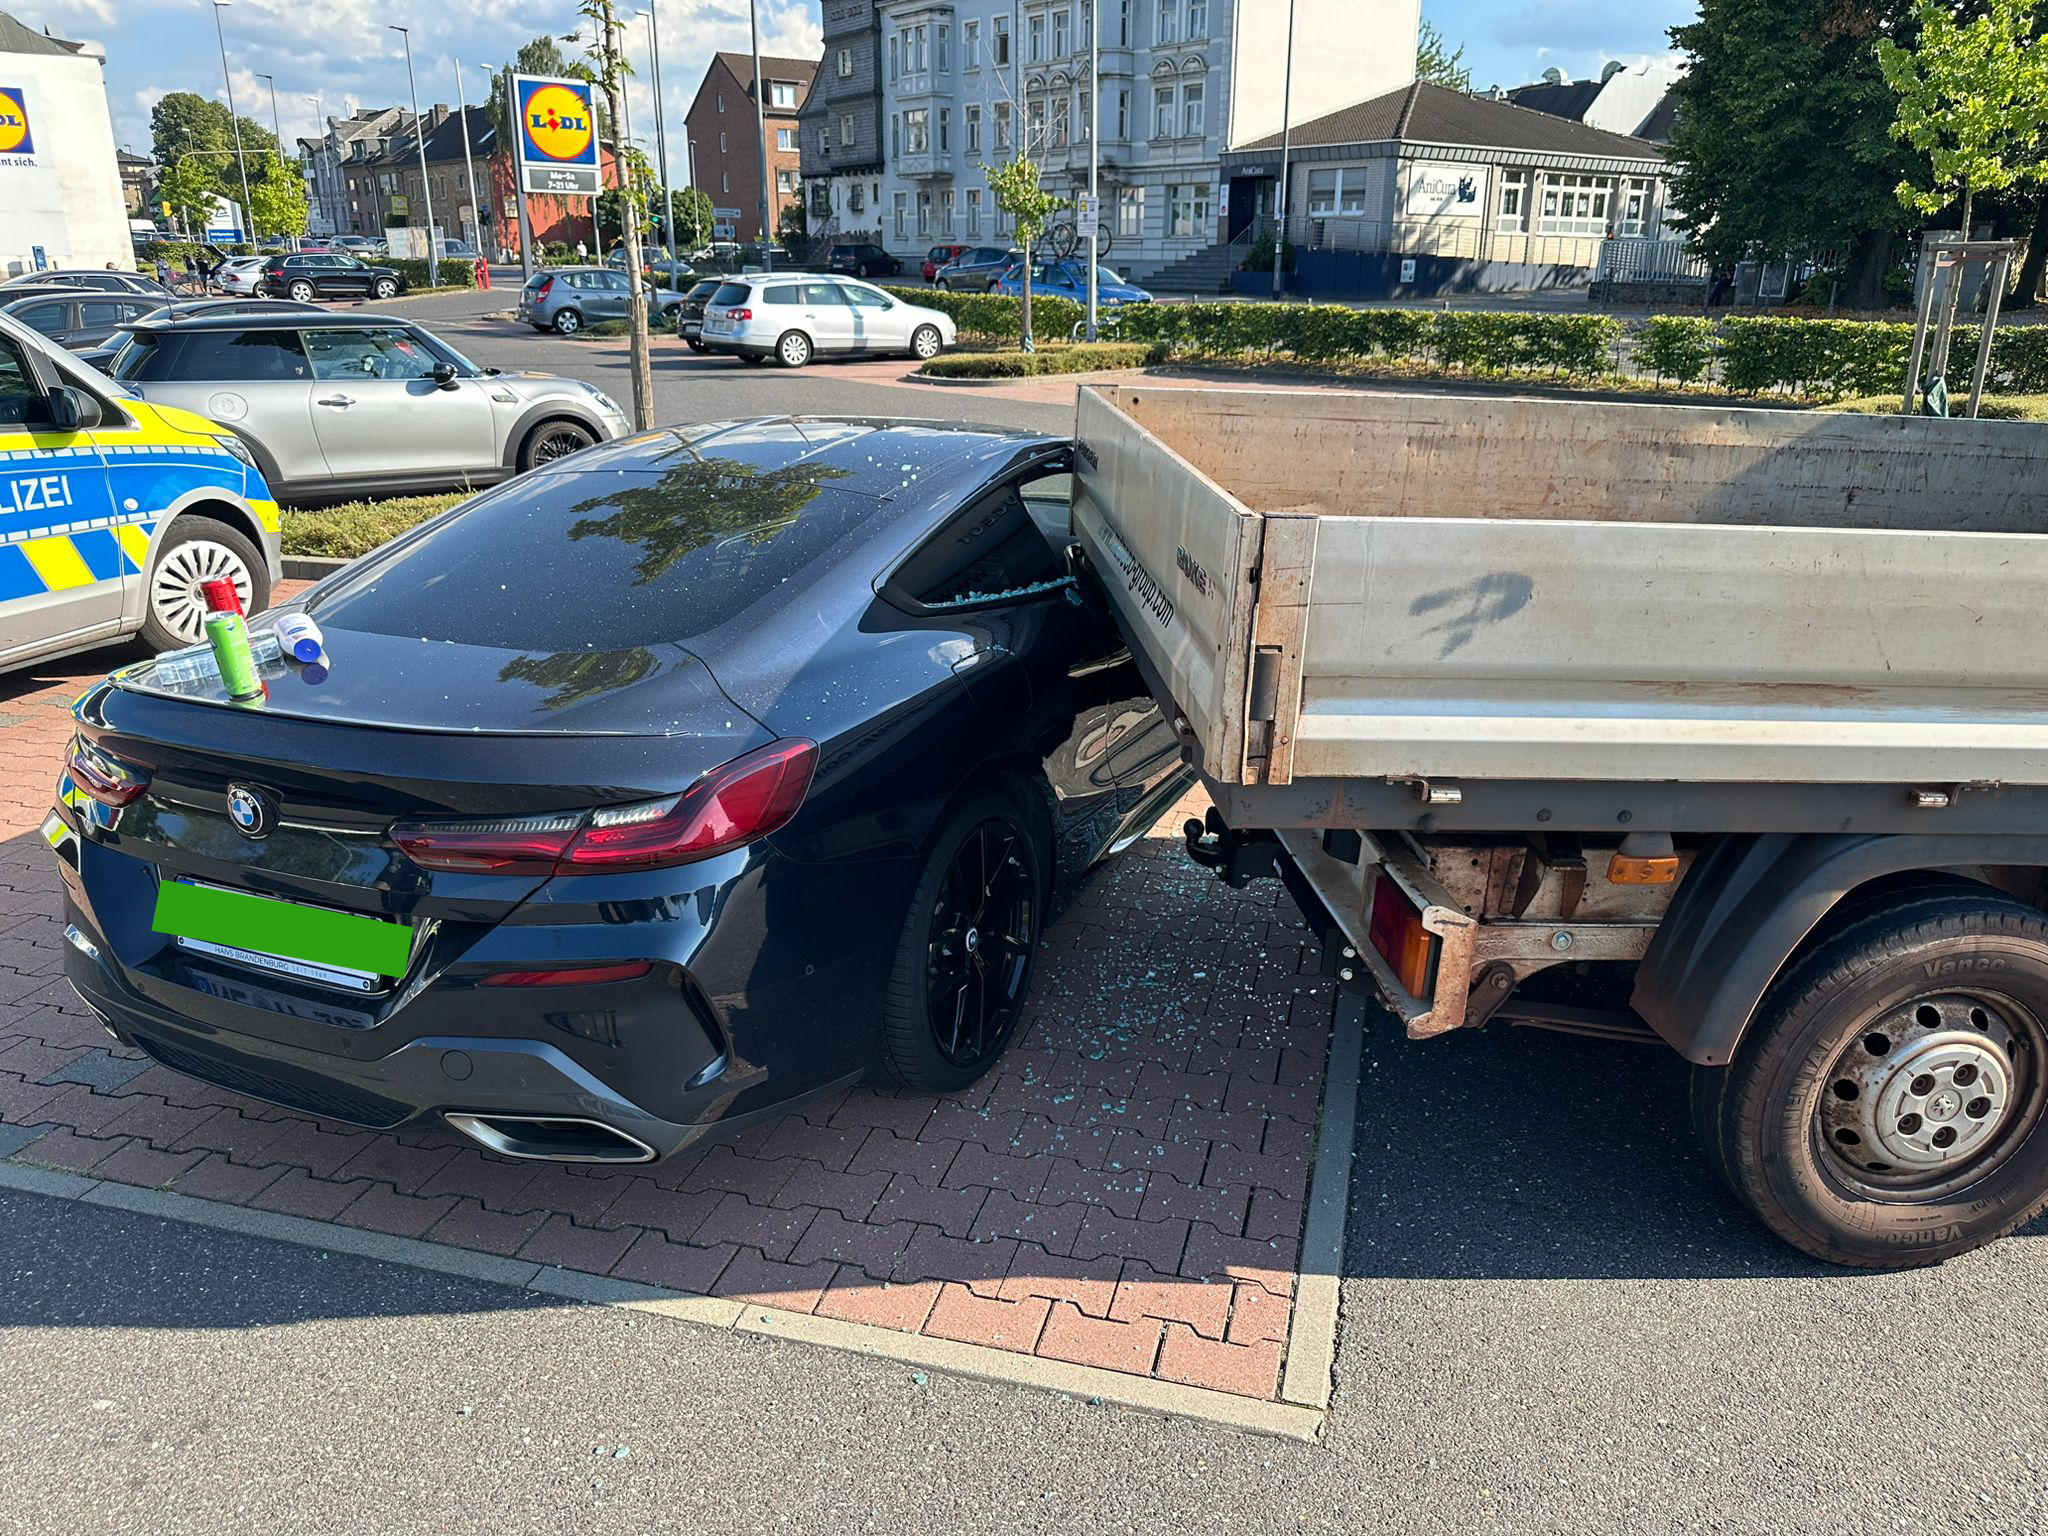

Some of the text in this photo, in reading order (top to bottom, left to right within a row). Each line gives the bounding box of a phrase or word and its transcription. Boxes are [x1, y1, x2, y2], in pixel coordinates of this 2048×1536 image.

[14, 157, 38, 167] sich.
[565, 181, 579, 190] Uhr
[1418, 179, 1456, 195] AniCura
[214, 946, 234, 957] HANS
[234, 951, 289, 970] BRANDENBURG
